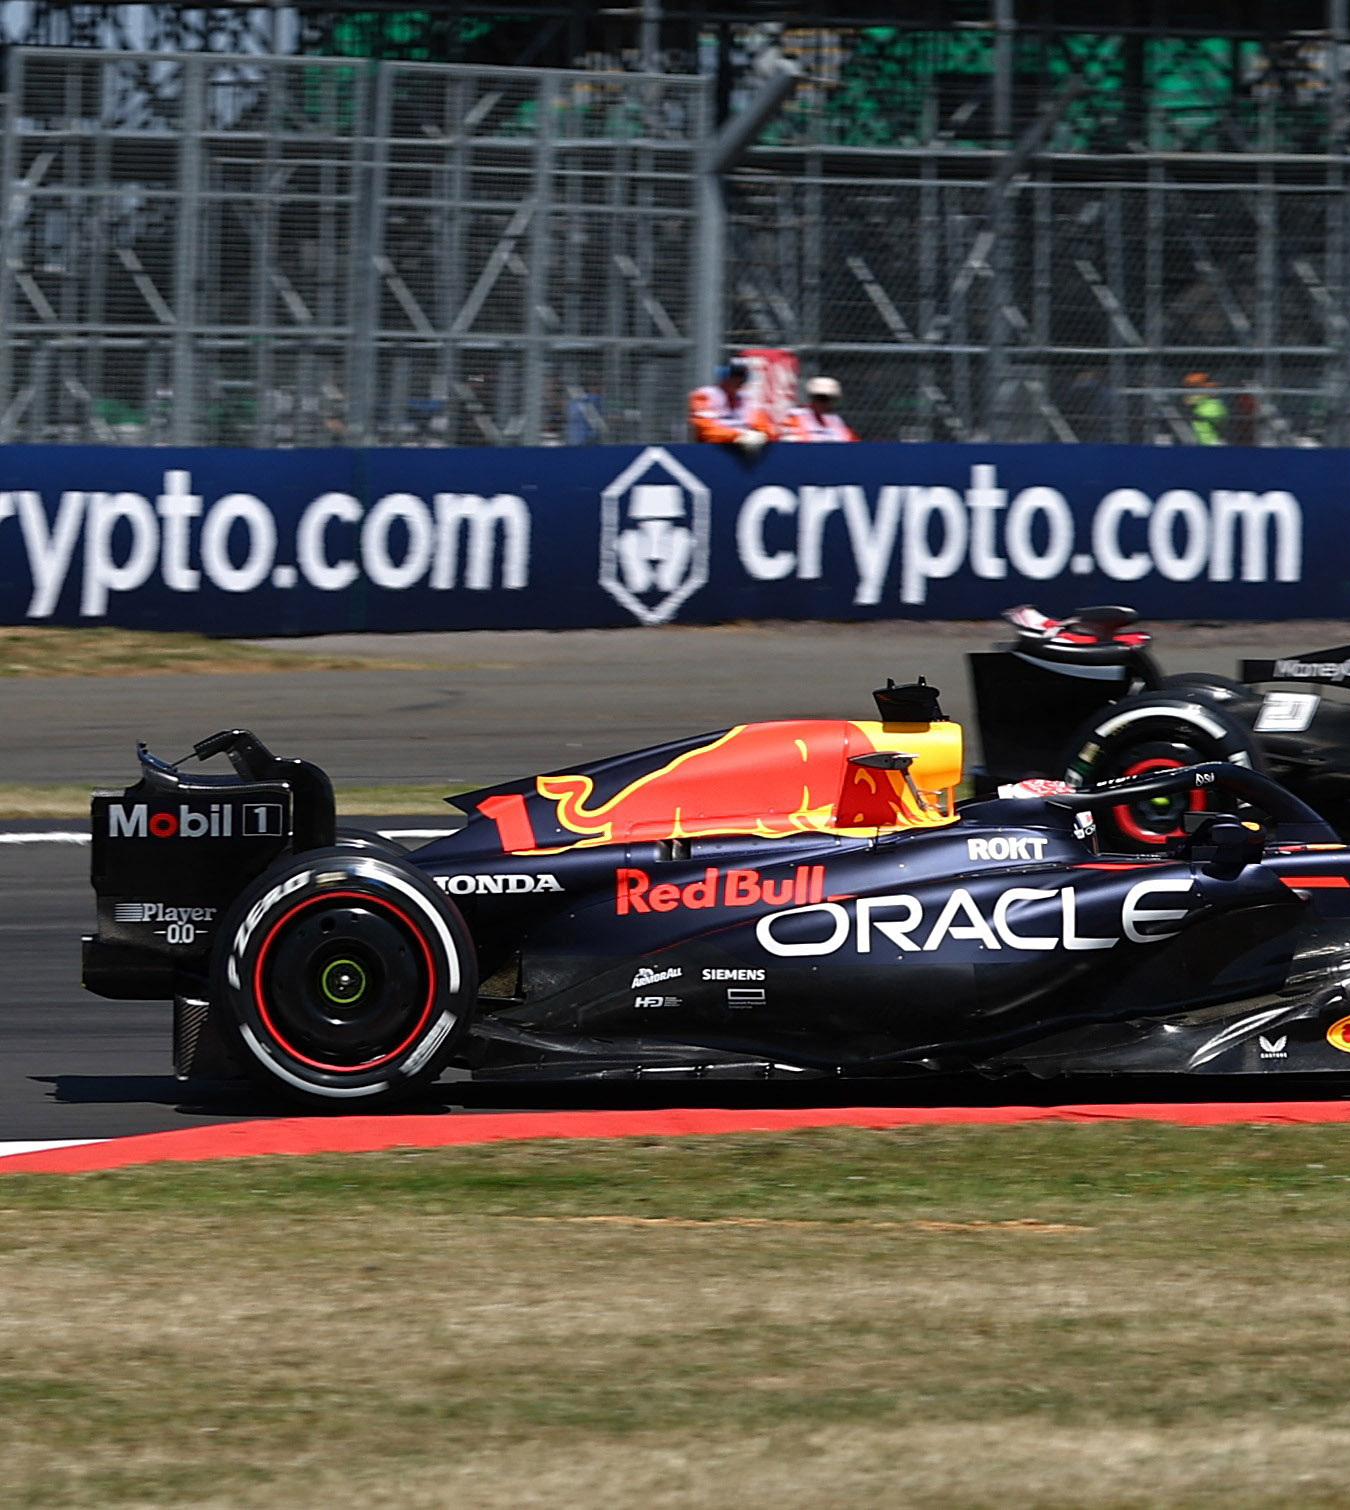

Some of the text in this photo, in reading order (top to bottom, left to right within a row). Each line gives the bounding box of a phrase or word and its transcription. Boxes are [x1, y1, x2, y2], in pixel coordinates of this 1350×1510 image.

[736, 464, 1301, 605] crypto.com
[108, 804, 268, 838] Mobil 1
[476, 794, 536, 852] 1
[967, 837, 1048, 861] ROKT
[616, 865, 826, 915] Red Bull
[142, 903, 217, 924] Player
[166, 924, 195, 944] 0.0
[233, 869, 317, 958] ZERO
[756, 878, 1196, 957] ORACLE
[702, 968, 766, 981] SIEMENS
